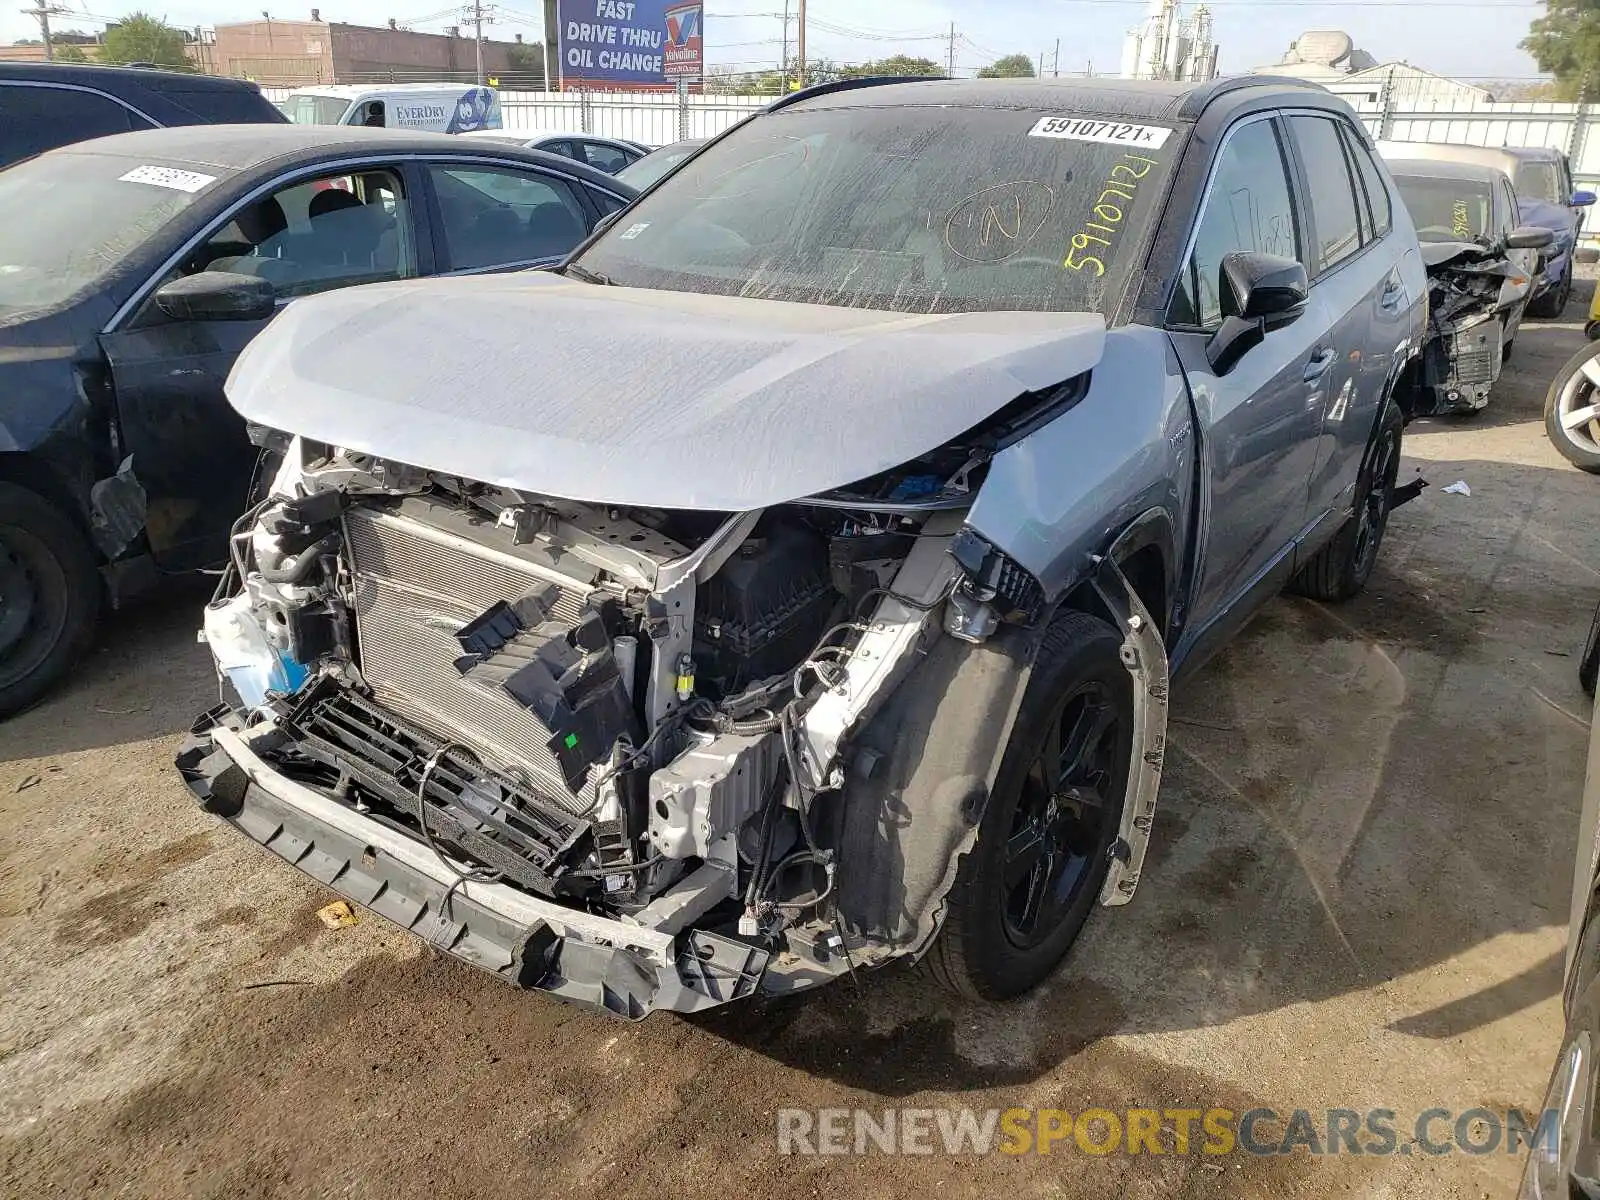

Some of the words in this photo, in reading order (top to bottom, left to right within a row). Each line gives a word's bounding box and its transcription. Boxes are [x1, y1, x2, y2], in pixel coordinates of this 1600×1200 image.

[596, 0, 636, 20] FAST
[567, 22, 617, 44] DRIVE
[621, 27, 661, 48] THRU
[567, 48, 594, 68] OIL
[599, 50, 662, 72] CHANGE
[665, 48, 697, 62] Valvoline
[398, 118, 446, 127] WATERPROOFING
[1064, 154, 1158, 276] 59107121
